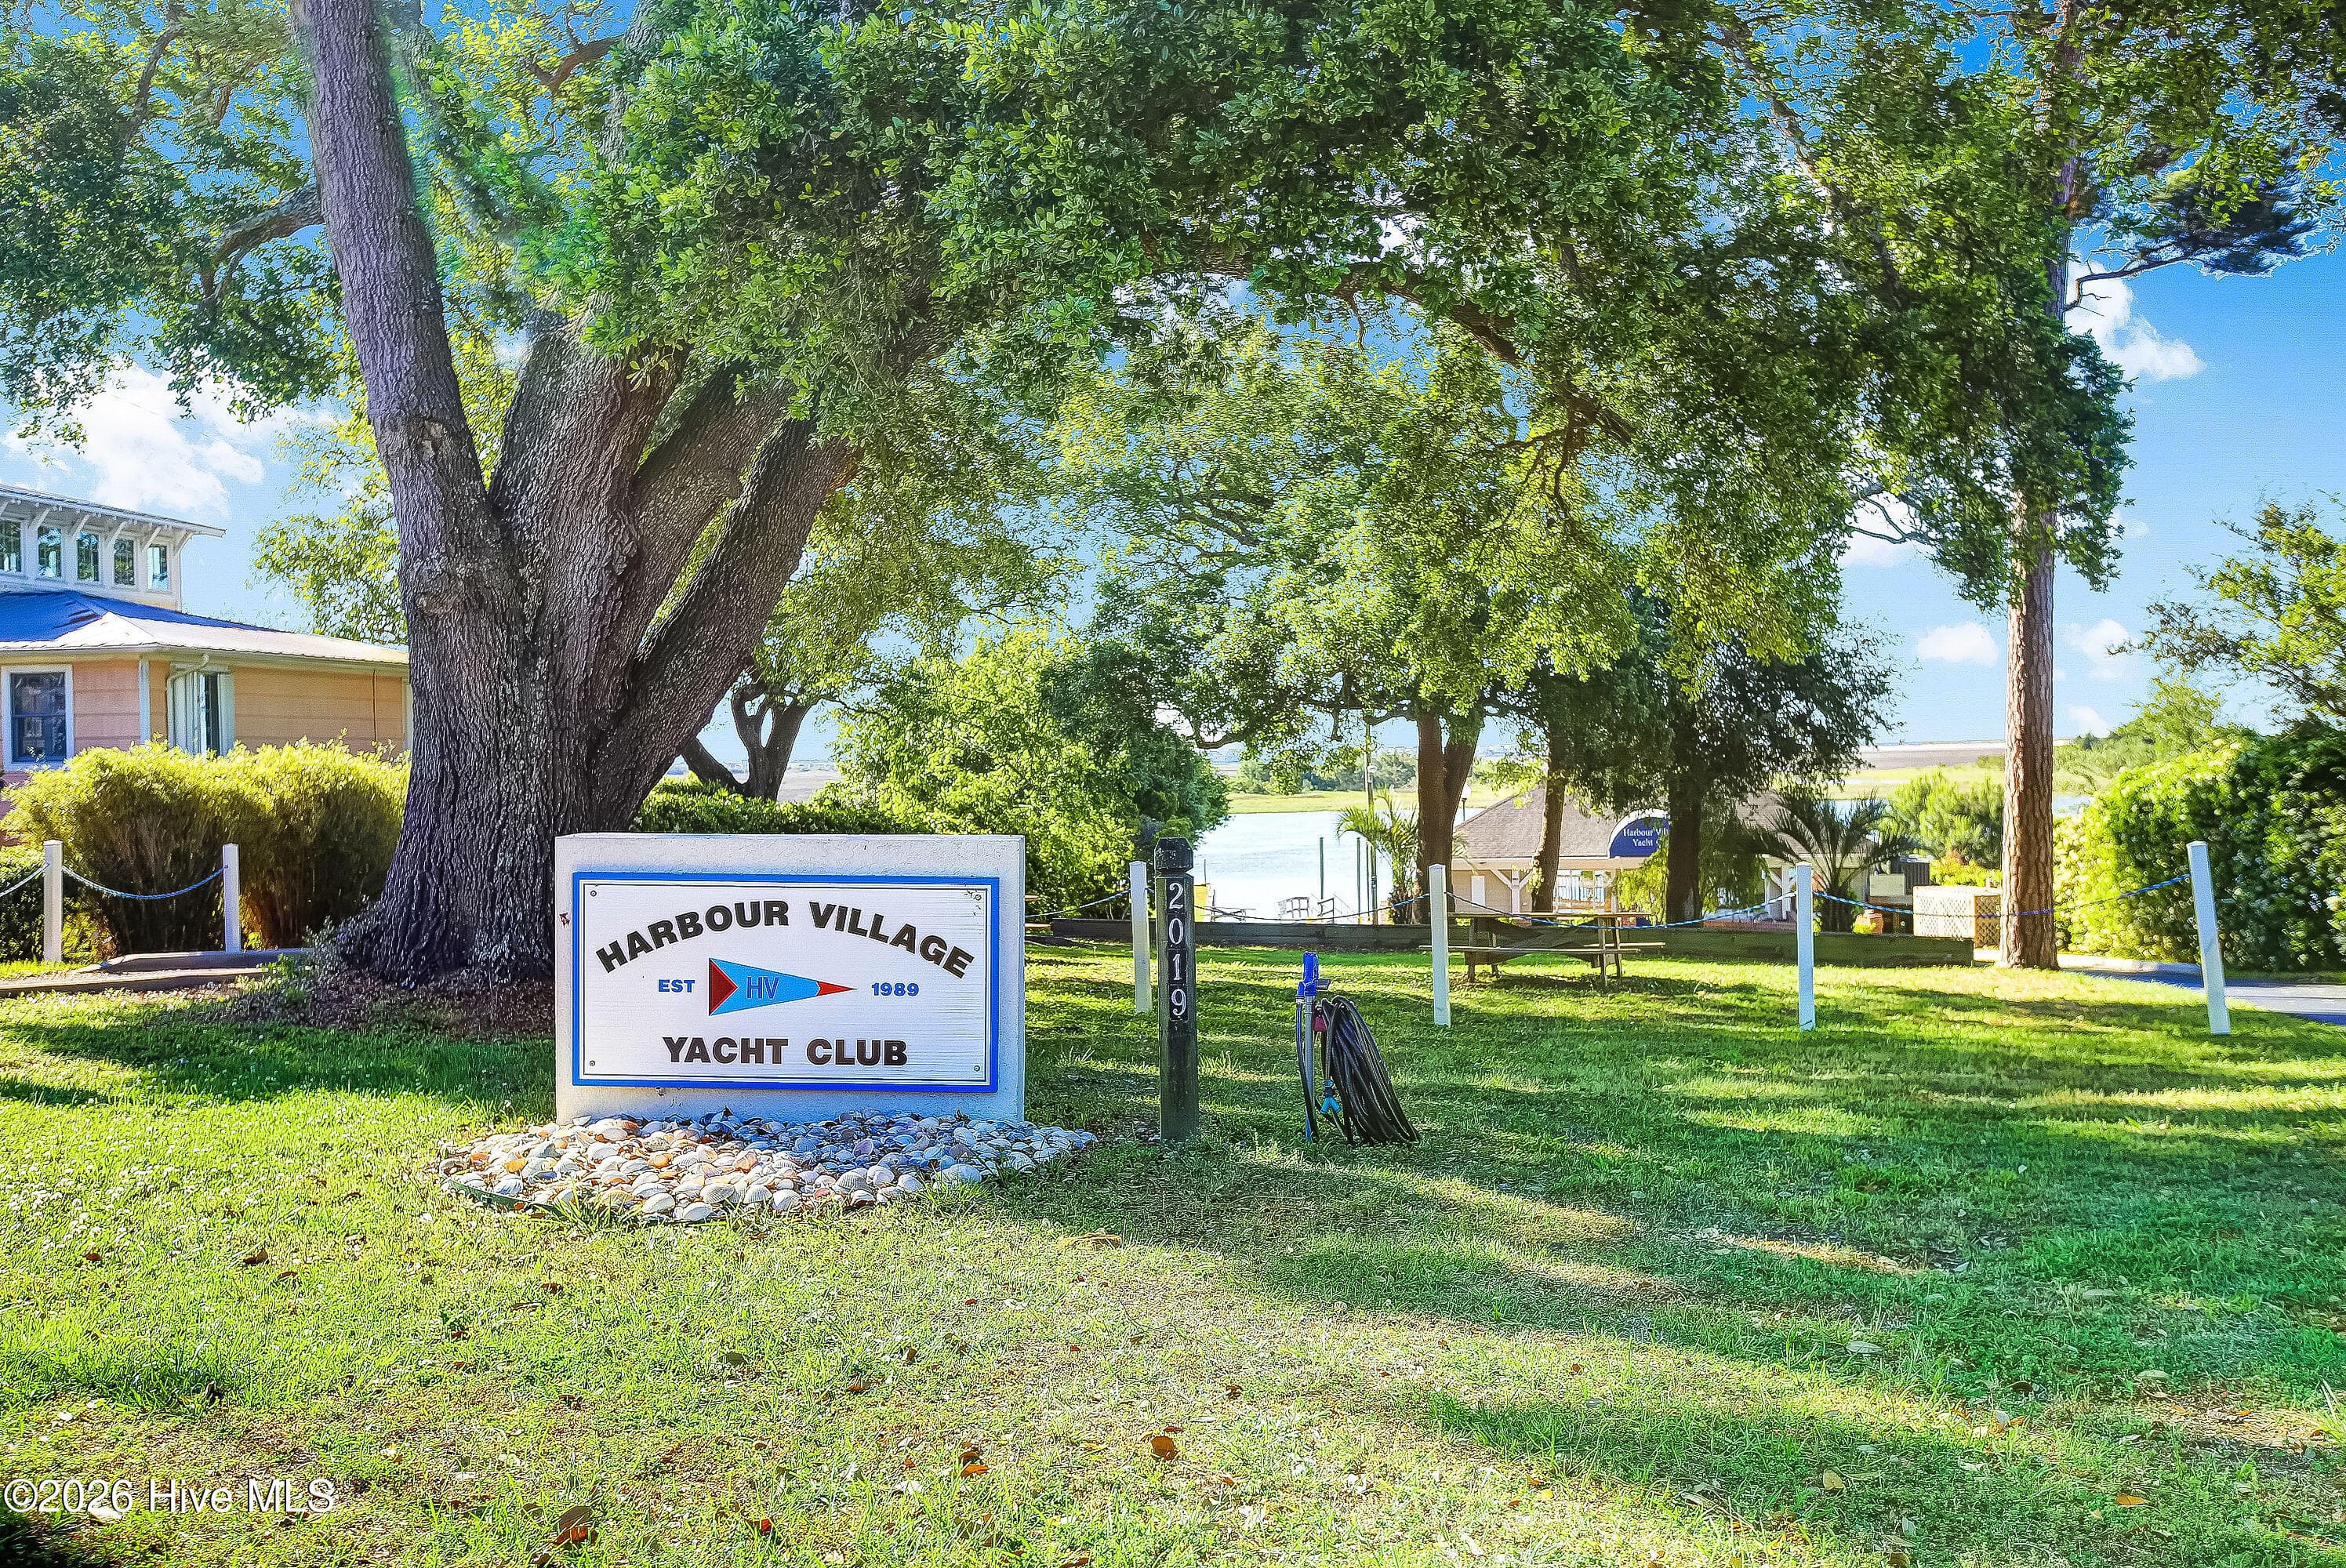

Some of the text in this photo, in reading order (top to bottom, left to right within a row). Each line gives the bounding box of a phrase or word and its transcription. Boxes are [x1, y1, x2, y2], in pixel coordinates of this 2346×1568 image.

[1623, 828, 1654, 837] Harbour
[1632, 838, 1654, 847] Yacht
[595, 900, 975, 979] HARBOUR VILLAGE
[1168, 882, 1187, 1017] 2019
[658, 978, 920, 996] EST 1989
[746, 976, 780, 1000] HV
[663, 1036, 908, 1066] YACHT CLUB
